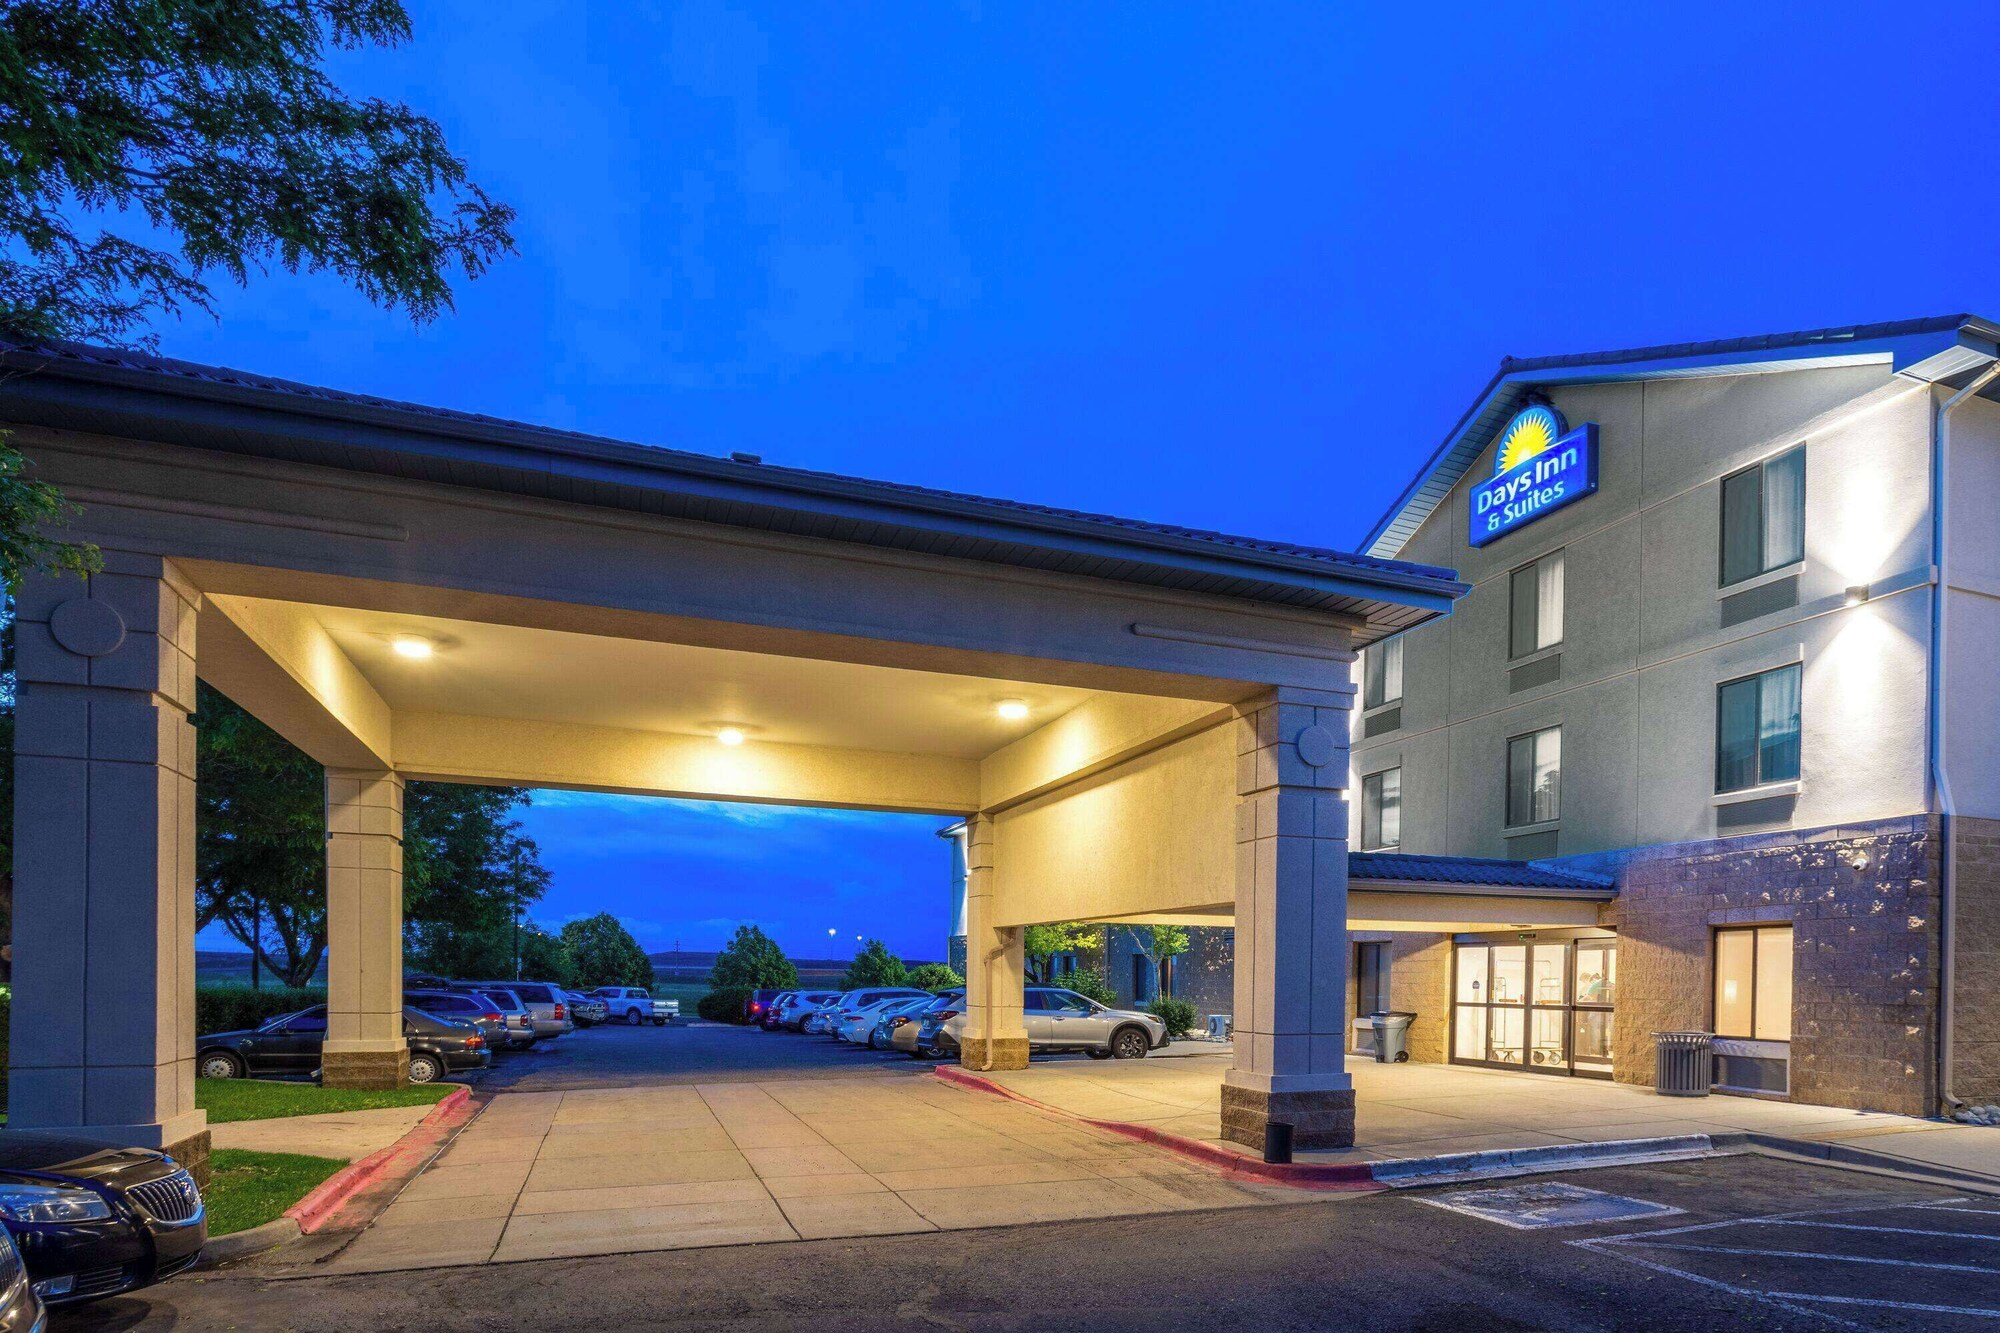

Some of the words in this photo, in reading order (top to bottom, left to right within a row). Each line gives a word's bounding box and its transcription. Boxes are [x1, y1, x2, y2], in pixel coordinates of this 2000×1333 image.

[1477, 470, 1532, 515] Days
[1535, 448, 1577, 484] Inn
[1487, 512, 1500, 531] &
[1503, 481, 1565, 524] Suites
